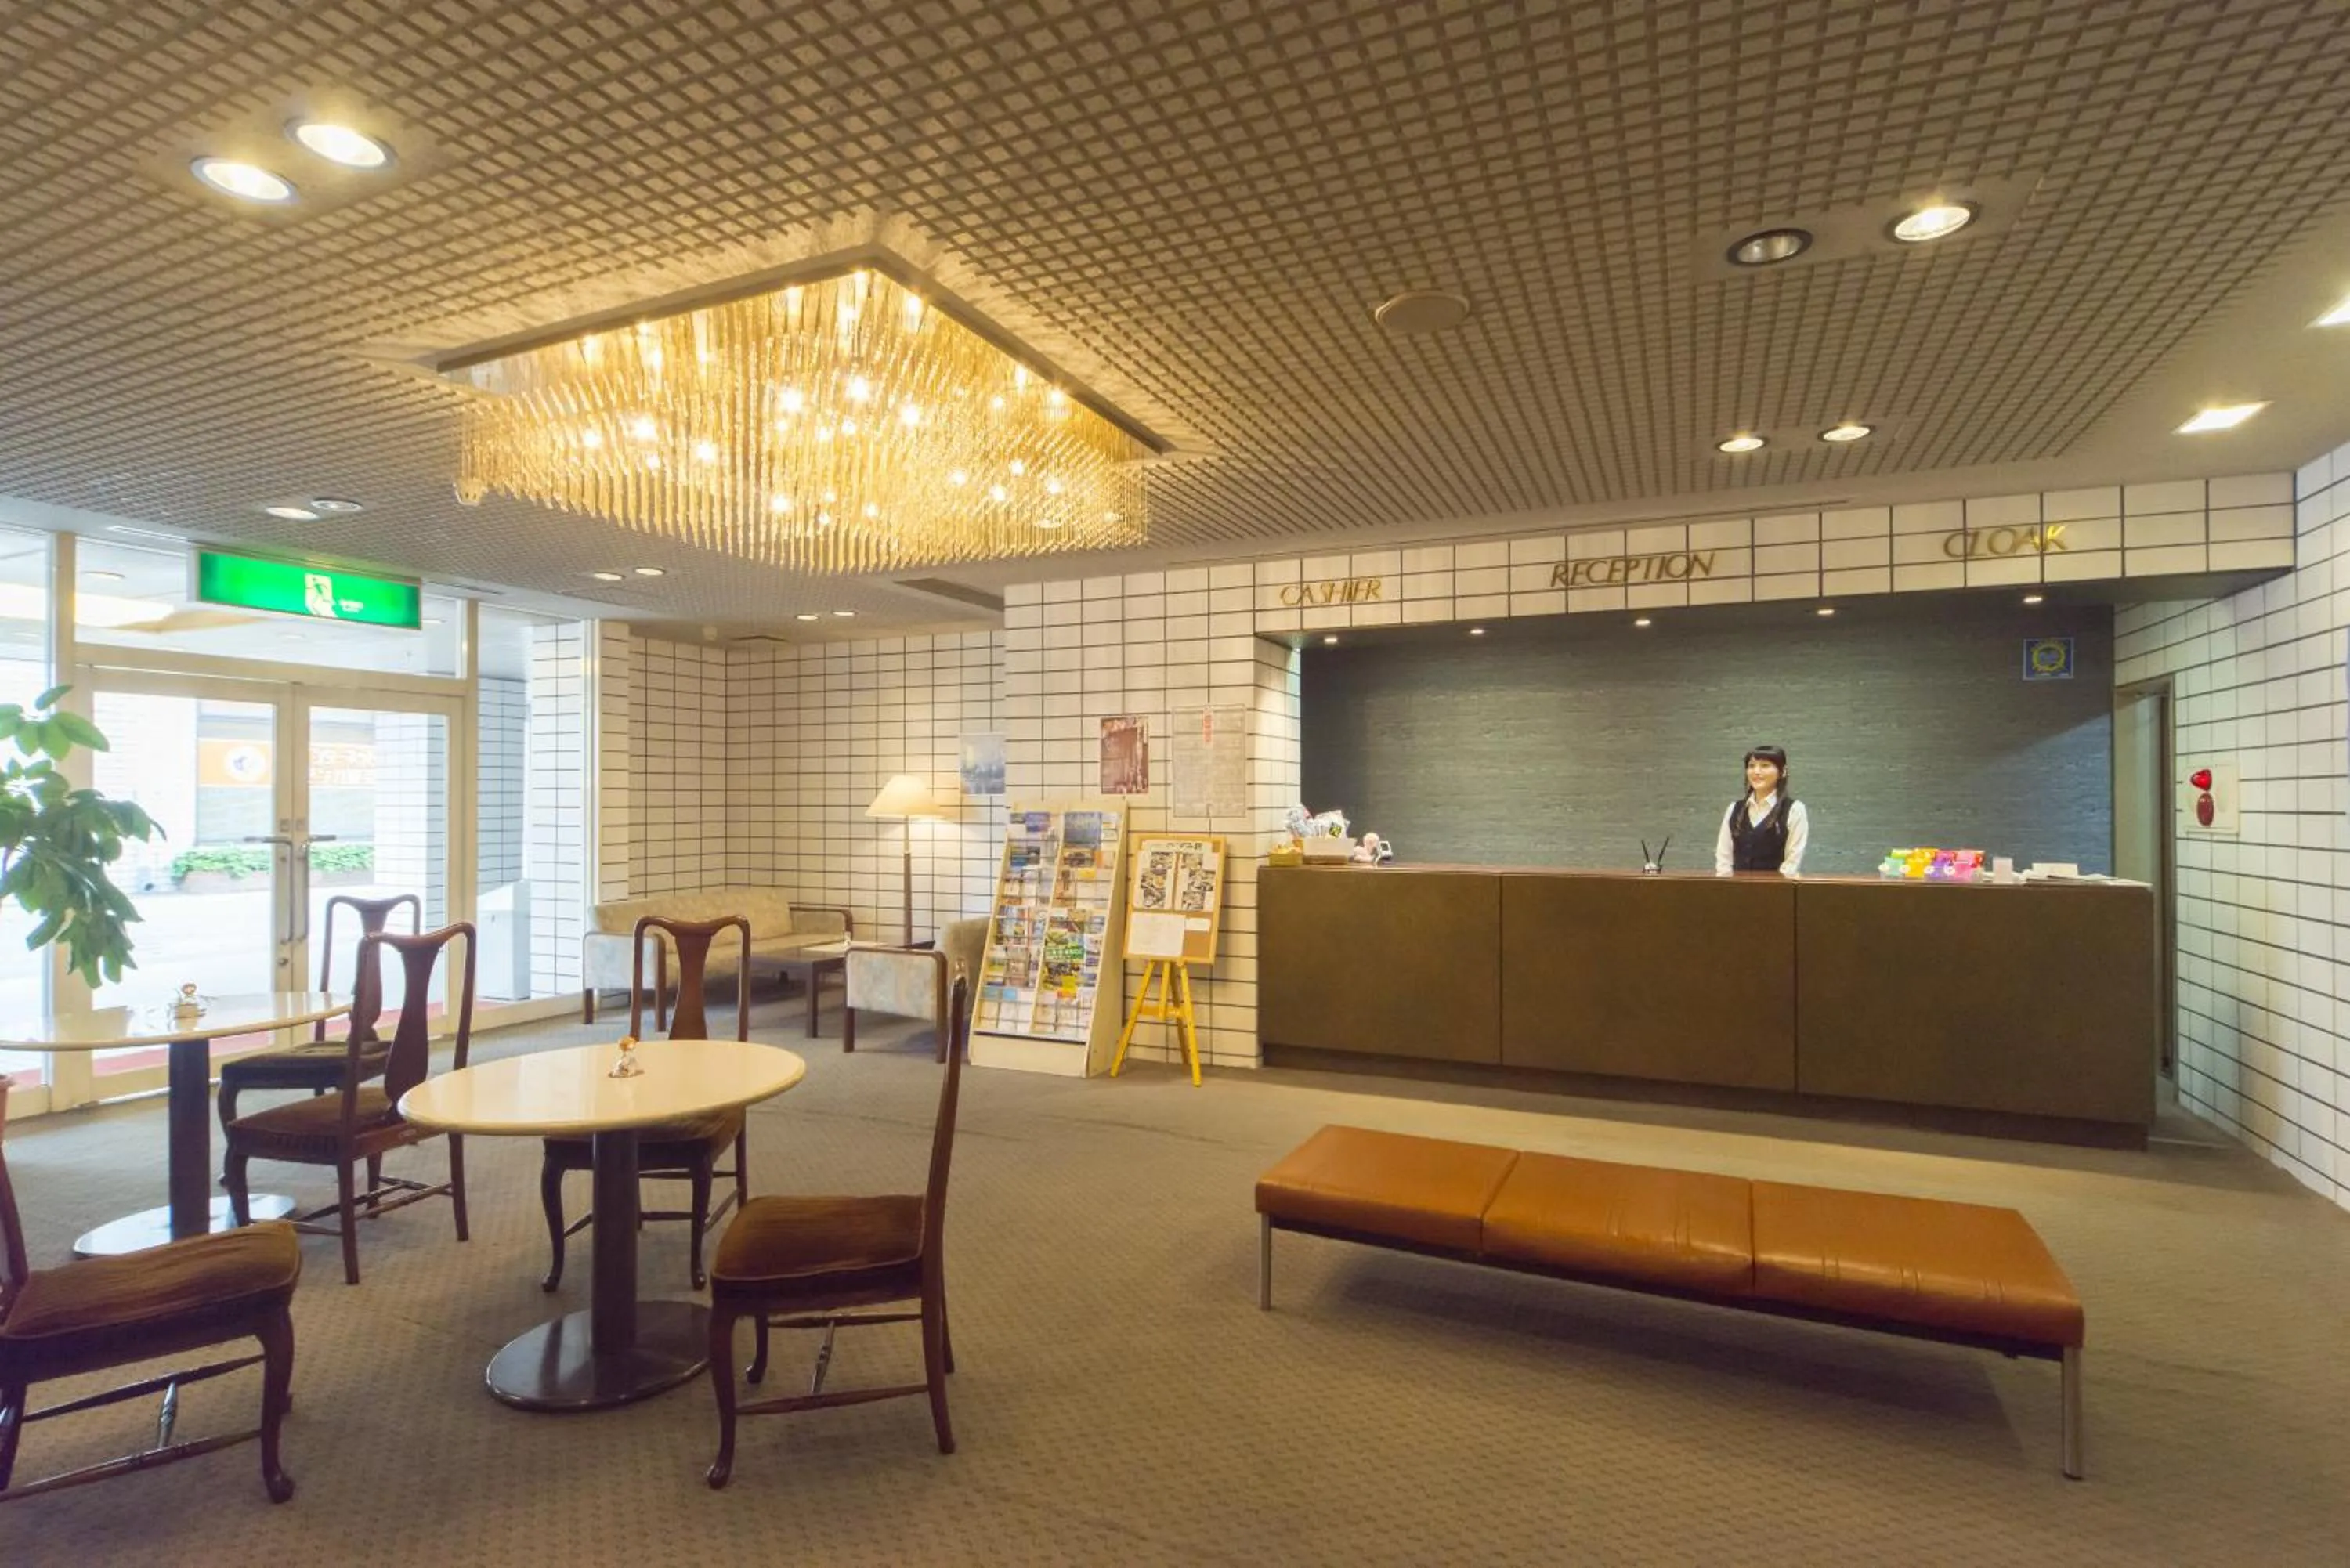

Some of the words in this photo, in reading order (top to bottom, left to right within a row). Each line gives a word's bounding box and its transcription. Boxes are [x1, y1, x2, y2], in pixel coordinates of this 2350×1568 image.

[1943, 525, 2068, 558] CLOAK
[1550, 552, 1716, 587] RECEPTION
[1279, 579, 1382, 605] CASHIER
